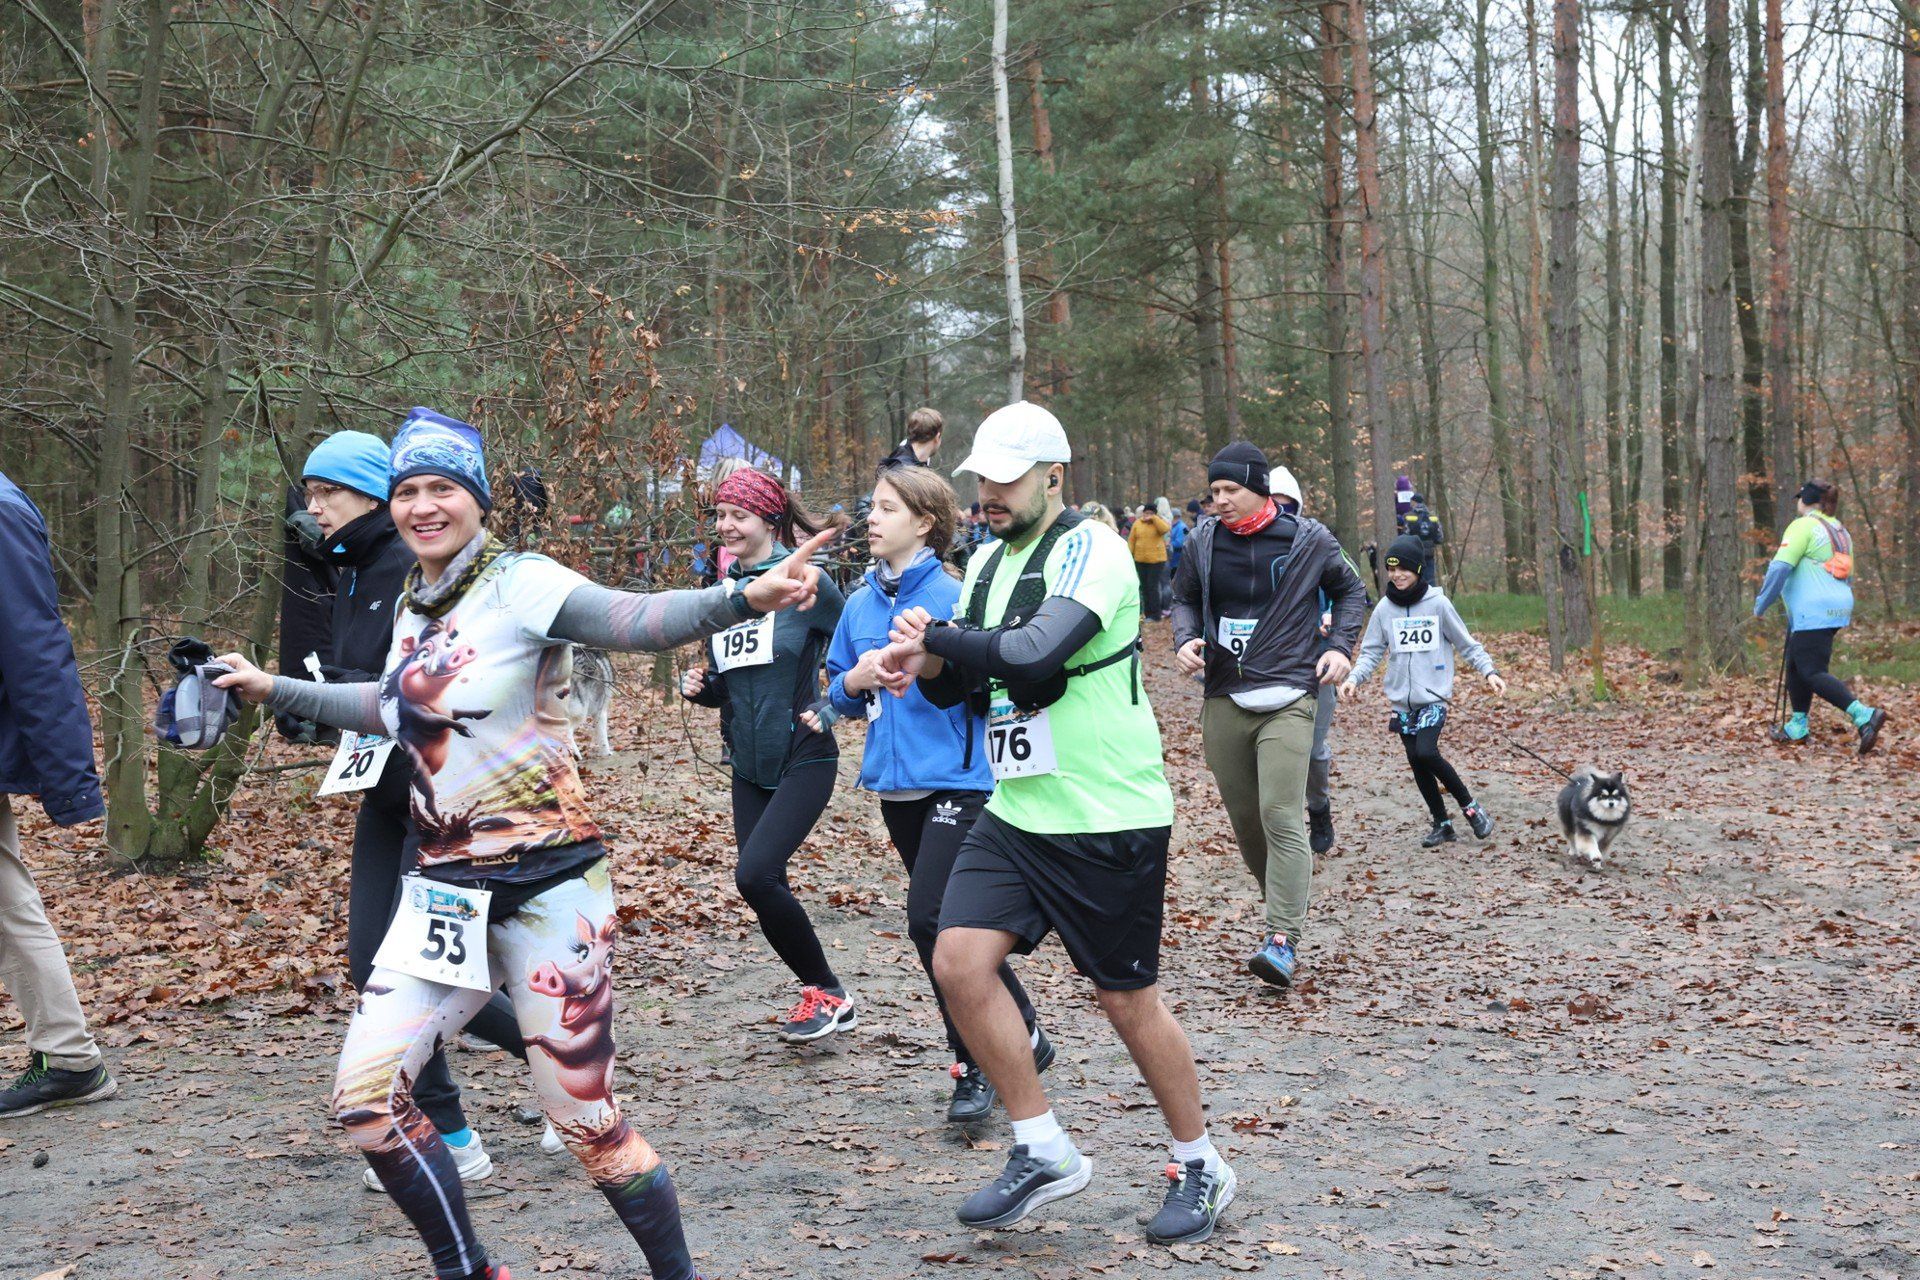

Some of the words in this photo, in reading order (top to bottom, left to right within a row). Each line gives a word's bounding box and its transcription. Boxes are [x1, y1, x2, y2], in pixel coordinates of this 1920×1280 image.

[723, 628, 759, 658] 195
[1231, 638, 1247, 658] 9
[1400, 629, 1433, 645] 240
[988, 727, 1032, 764] 176
[338, 750, 375, 779] 20
[932, 815, 957, 825] adidas
[420, 918, 467, 965] 53
